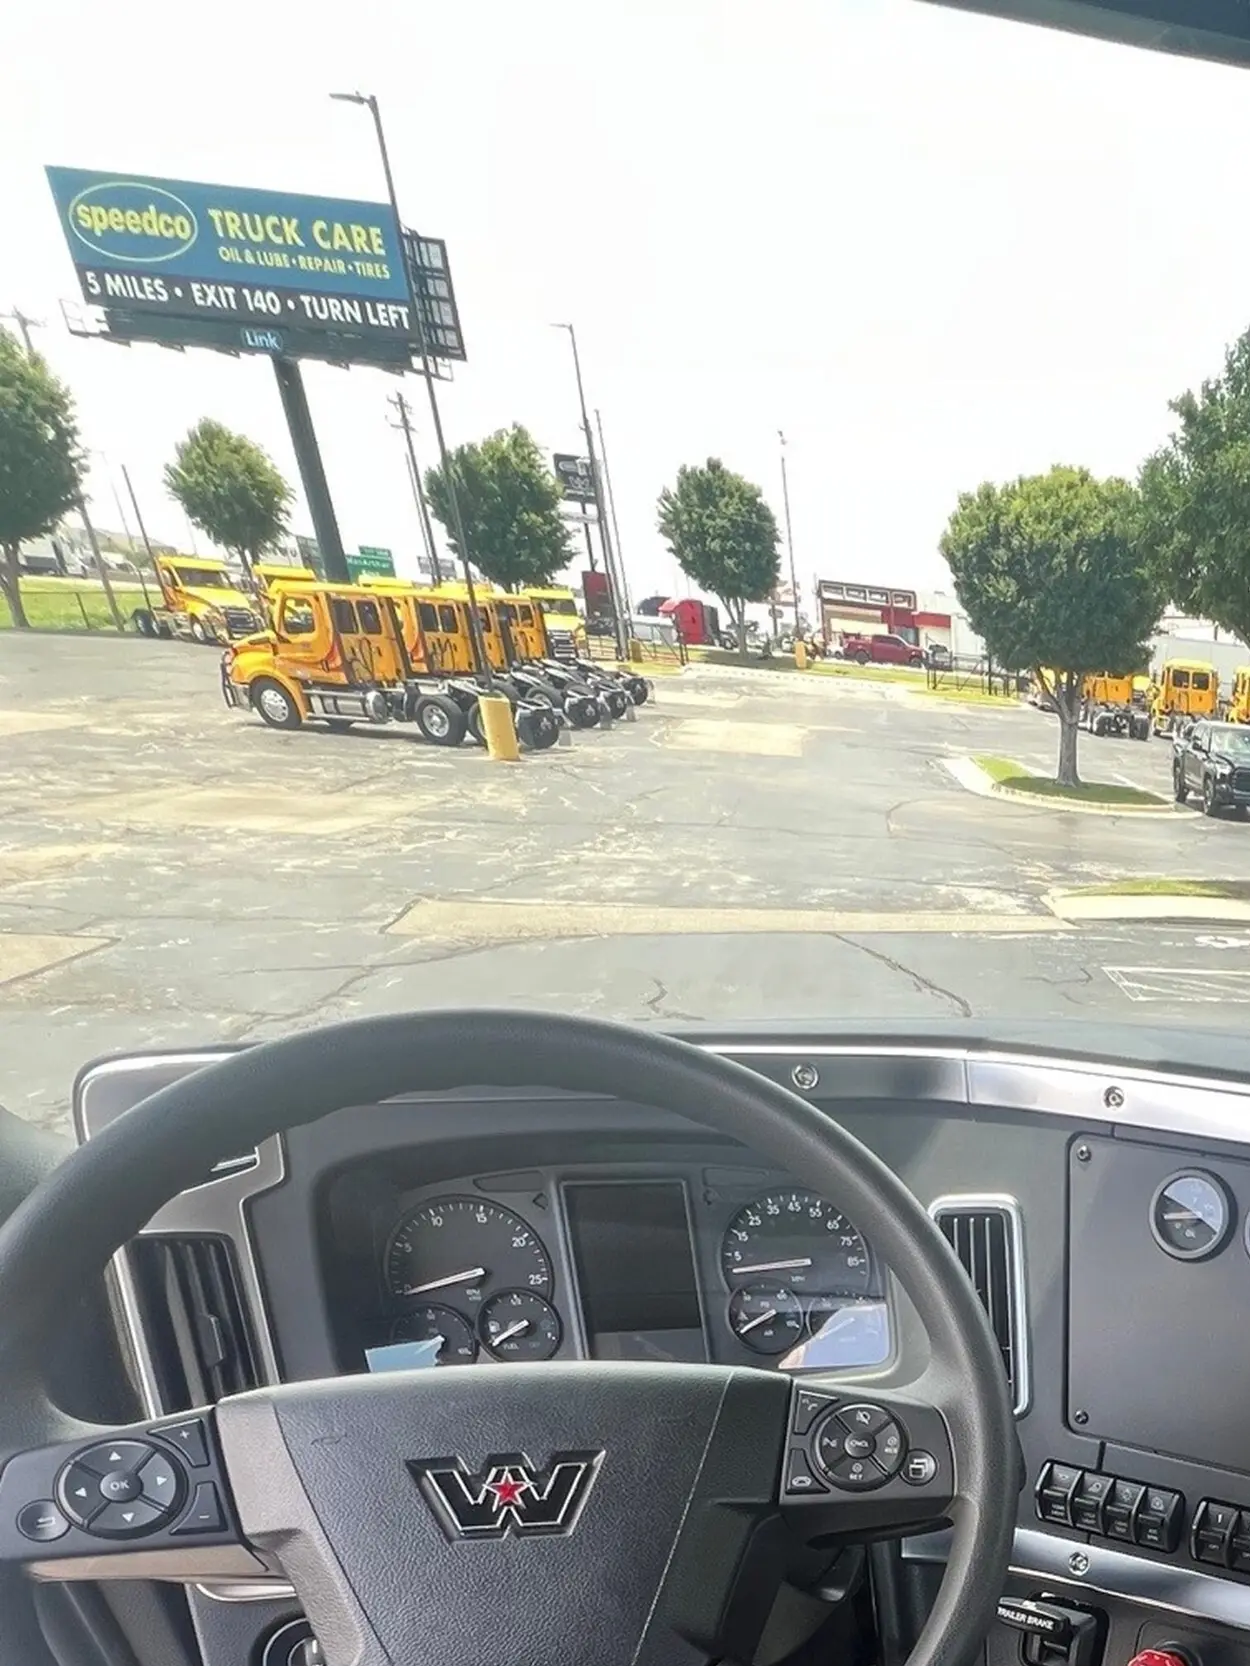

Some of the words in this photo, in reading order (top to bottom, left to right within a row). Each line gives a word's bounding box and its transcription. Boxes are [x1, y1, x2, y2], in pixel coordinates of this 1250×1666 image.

[76, 204, 192, 241] speedco
[207, 208, 305, 248] TRUCK
[312, 219, 387, 256] CARE
[217, 246, 242, 264] OIL
[244, 249, 256, 265] &
[256, 251, 291, 269] LUBE
[297, 254, 347, 275] REPAIR
[350, 261, 391, 280] TIRES
[86, 271, 102, 296] 5
[104, 273, 169, 302] MILES
[190, 282, 238, 310] EXIT
[242, 288, 282, 316] 140
[299, 294, 364, 324] TURN
[364, 301, 411, 330] LEFT
[244, 330, 279, 351] Link
[767, 1205, 780, 1216] 35
[788, 1202, 801, 1212] 45
[809, 1207, 822, 1218] 55
[431, 1217, 443, 1228] 10
[475, 1213, 488, 1224] 15
[749, 1216, 762, 1226] 25
[826, 1220, 840, 1231] 65
[738, 1231, 749, 1242] 15
[840, 1236, 853, 1246] 75
[511, 1237, 526, 1248] 20
[847, 1257, 860, 1267] 85
[529, 1274, 543, 1286] 25
[109, 1479, 130, 1492] OK
[997, 1606, 1027, 1623] TRAILER
[1027, 1615, 1055, 1631] BRAKE
